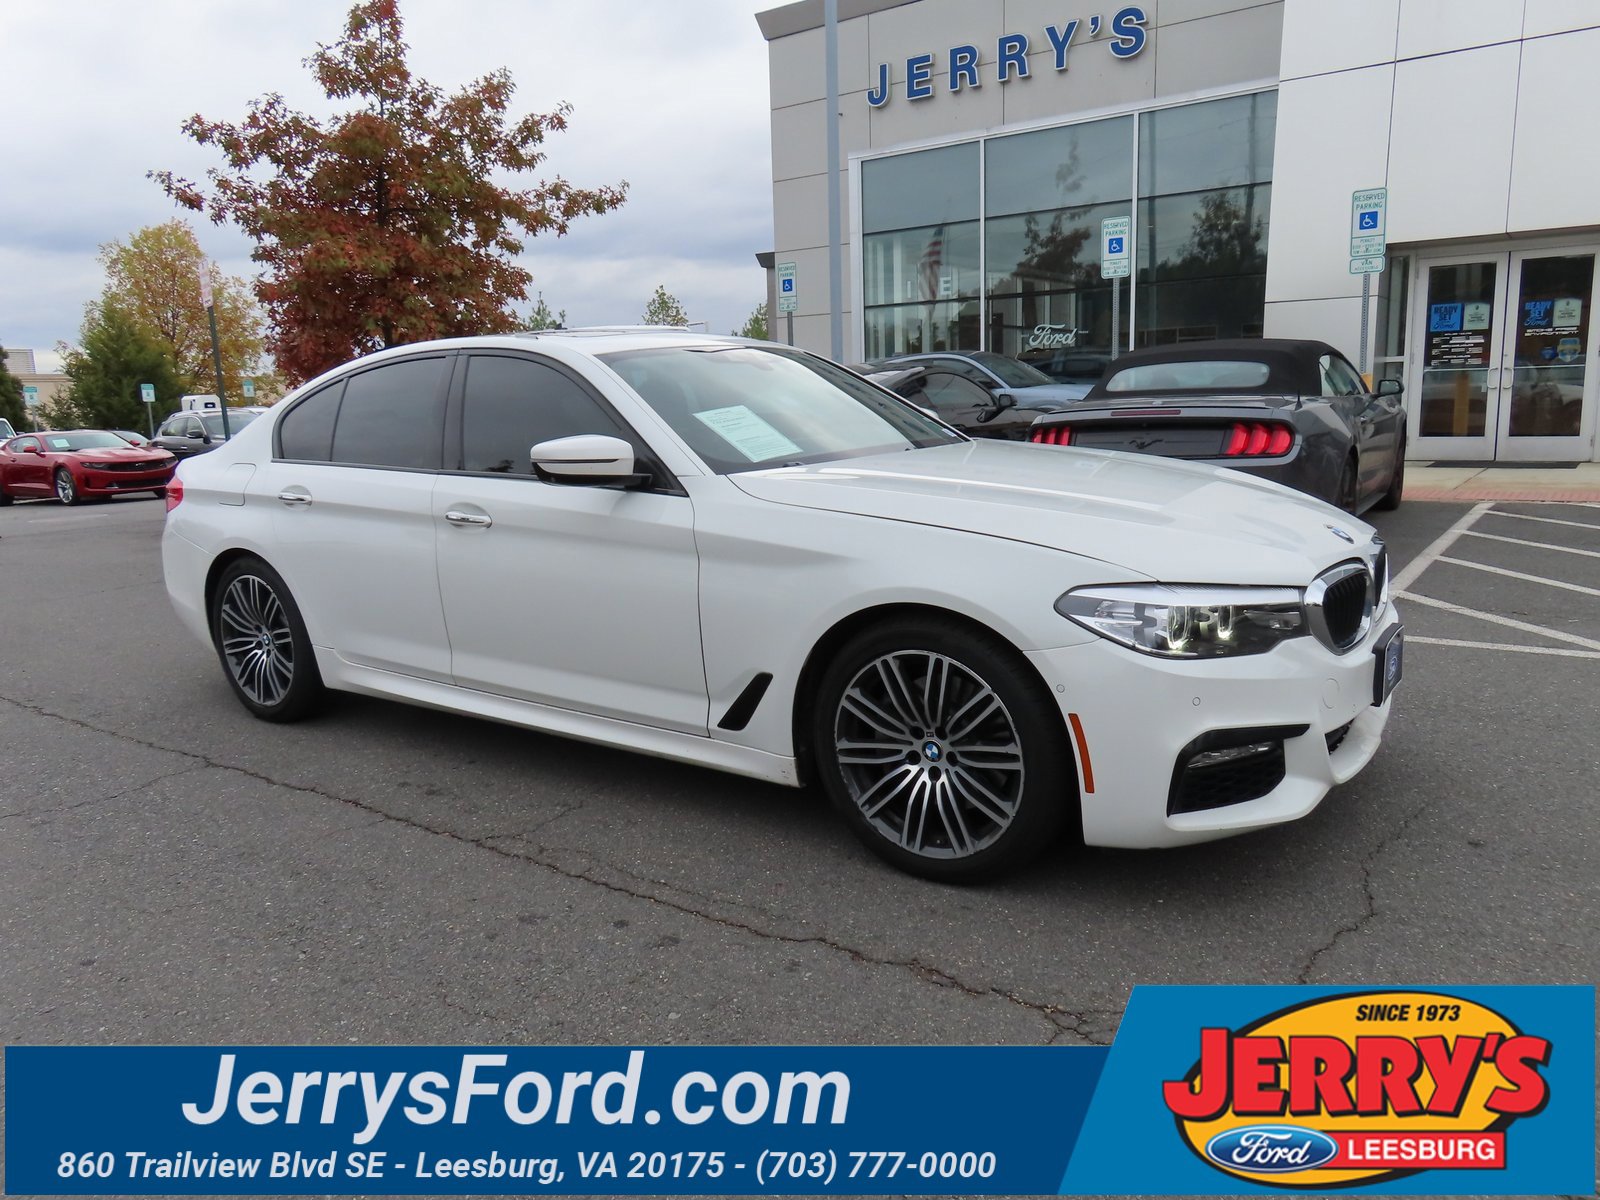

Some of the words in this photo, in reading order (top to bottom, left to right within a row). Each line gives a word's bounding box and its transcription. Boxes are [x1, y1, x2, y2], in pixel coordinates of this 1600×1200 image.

[867, 6, 1148, 107] JERRY'S
[1354, 192, 1385, 201] RESERVED
[1356, 202, 1383, 210] PARKING
[1029, 324, 1078, 346] Ford
